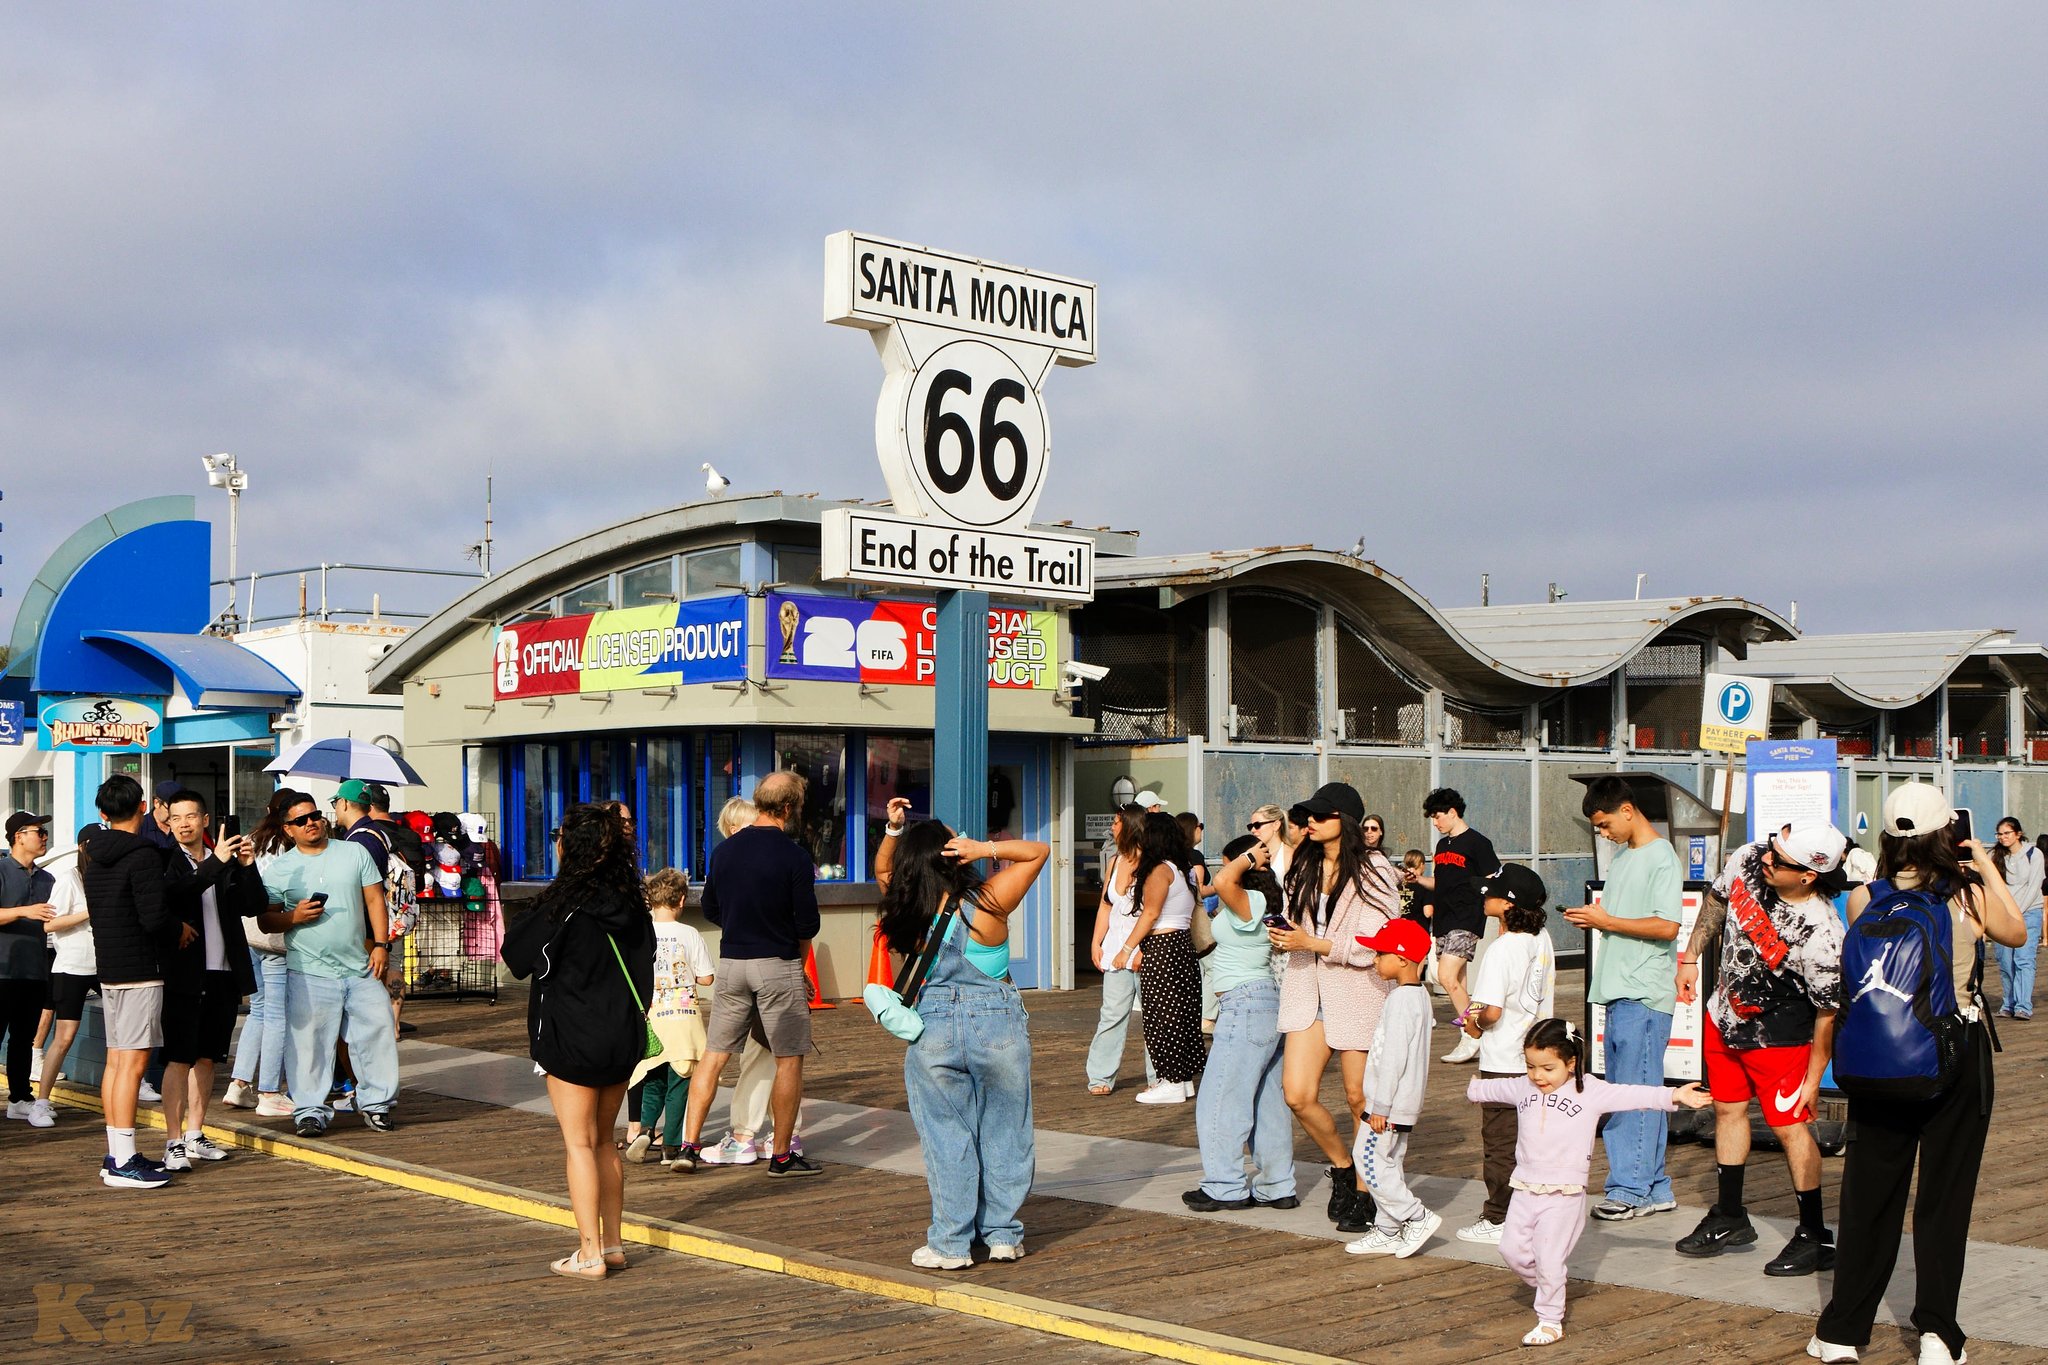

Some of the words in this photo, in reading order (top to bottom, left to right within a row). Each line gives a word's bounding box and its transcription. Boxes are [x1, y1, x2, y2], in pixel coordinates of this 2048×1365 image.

[860, 252, 958, 317] SANTA
[971, 277, 1087, 341] MONICA
[924, 369, 1028, 501] 66
[861, 528, 917, 571] End
[929, 534, 959, 574] of
[969, 537, 1014, 580] the
[1024, 547, 1082, 587] Trail
[921, 607, 1042, 636] OCIAL
[522, 637, 584, 677] OFFICIAL
[588, 629, 661, 669] LICENSED
[663, 620, 742, 663] PRODUCT
[871, 649, 894, 661] FIFA
[916, 632, 1046, 660] LISED
[916, 658, 1046, 686] PUCT
[1727, 688, 1746, 717] P
[53, 719, 101, 747] BLAZING
[102, 721, 148, 747] SADDLES
[1706, 727, 1720, 736] PAY
[1723, 730, 1745, 739] HERE
[1769, 747, 1788, 757] SANTA
[1789, 746, 1814, 756] MONICA
[1729, 876, 1790, 971] PANTERA
[1518, 1094, 1538, 1113] GAP
[1542, 1094, 1583, 1117] 1969
